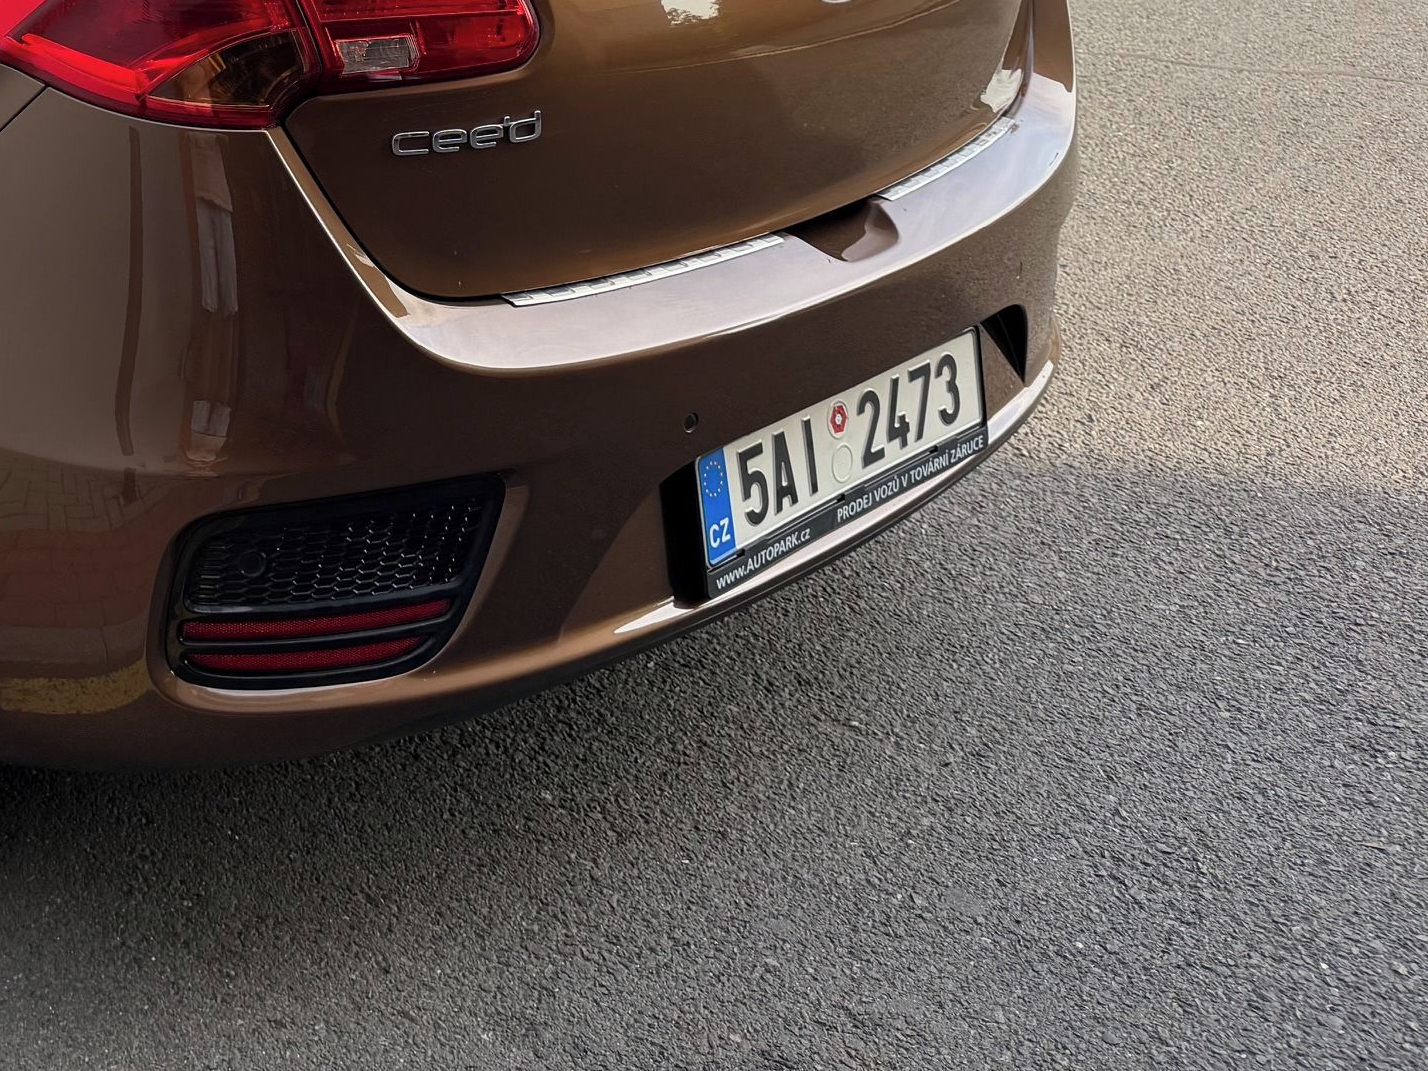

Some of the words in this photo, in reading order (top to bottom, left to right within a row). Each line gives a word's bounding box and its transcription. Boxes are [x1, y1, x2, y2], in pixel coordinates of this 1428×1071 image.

[392, 110, 542, 156] cee'd
[737, 416, 819, 526] 5AI
[857, 352, 961, 470] 2473
[837, 492, 872, 523] PRODEJ
[874, 474, 900, 502] VOZŮ
[901, 473, 908, 488] V
[909, 449, 949, 483] TOVÁRNÍ
[950, 435, 984, 463] ZÁRUCE
[709, 517, 731, 548] CZ
